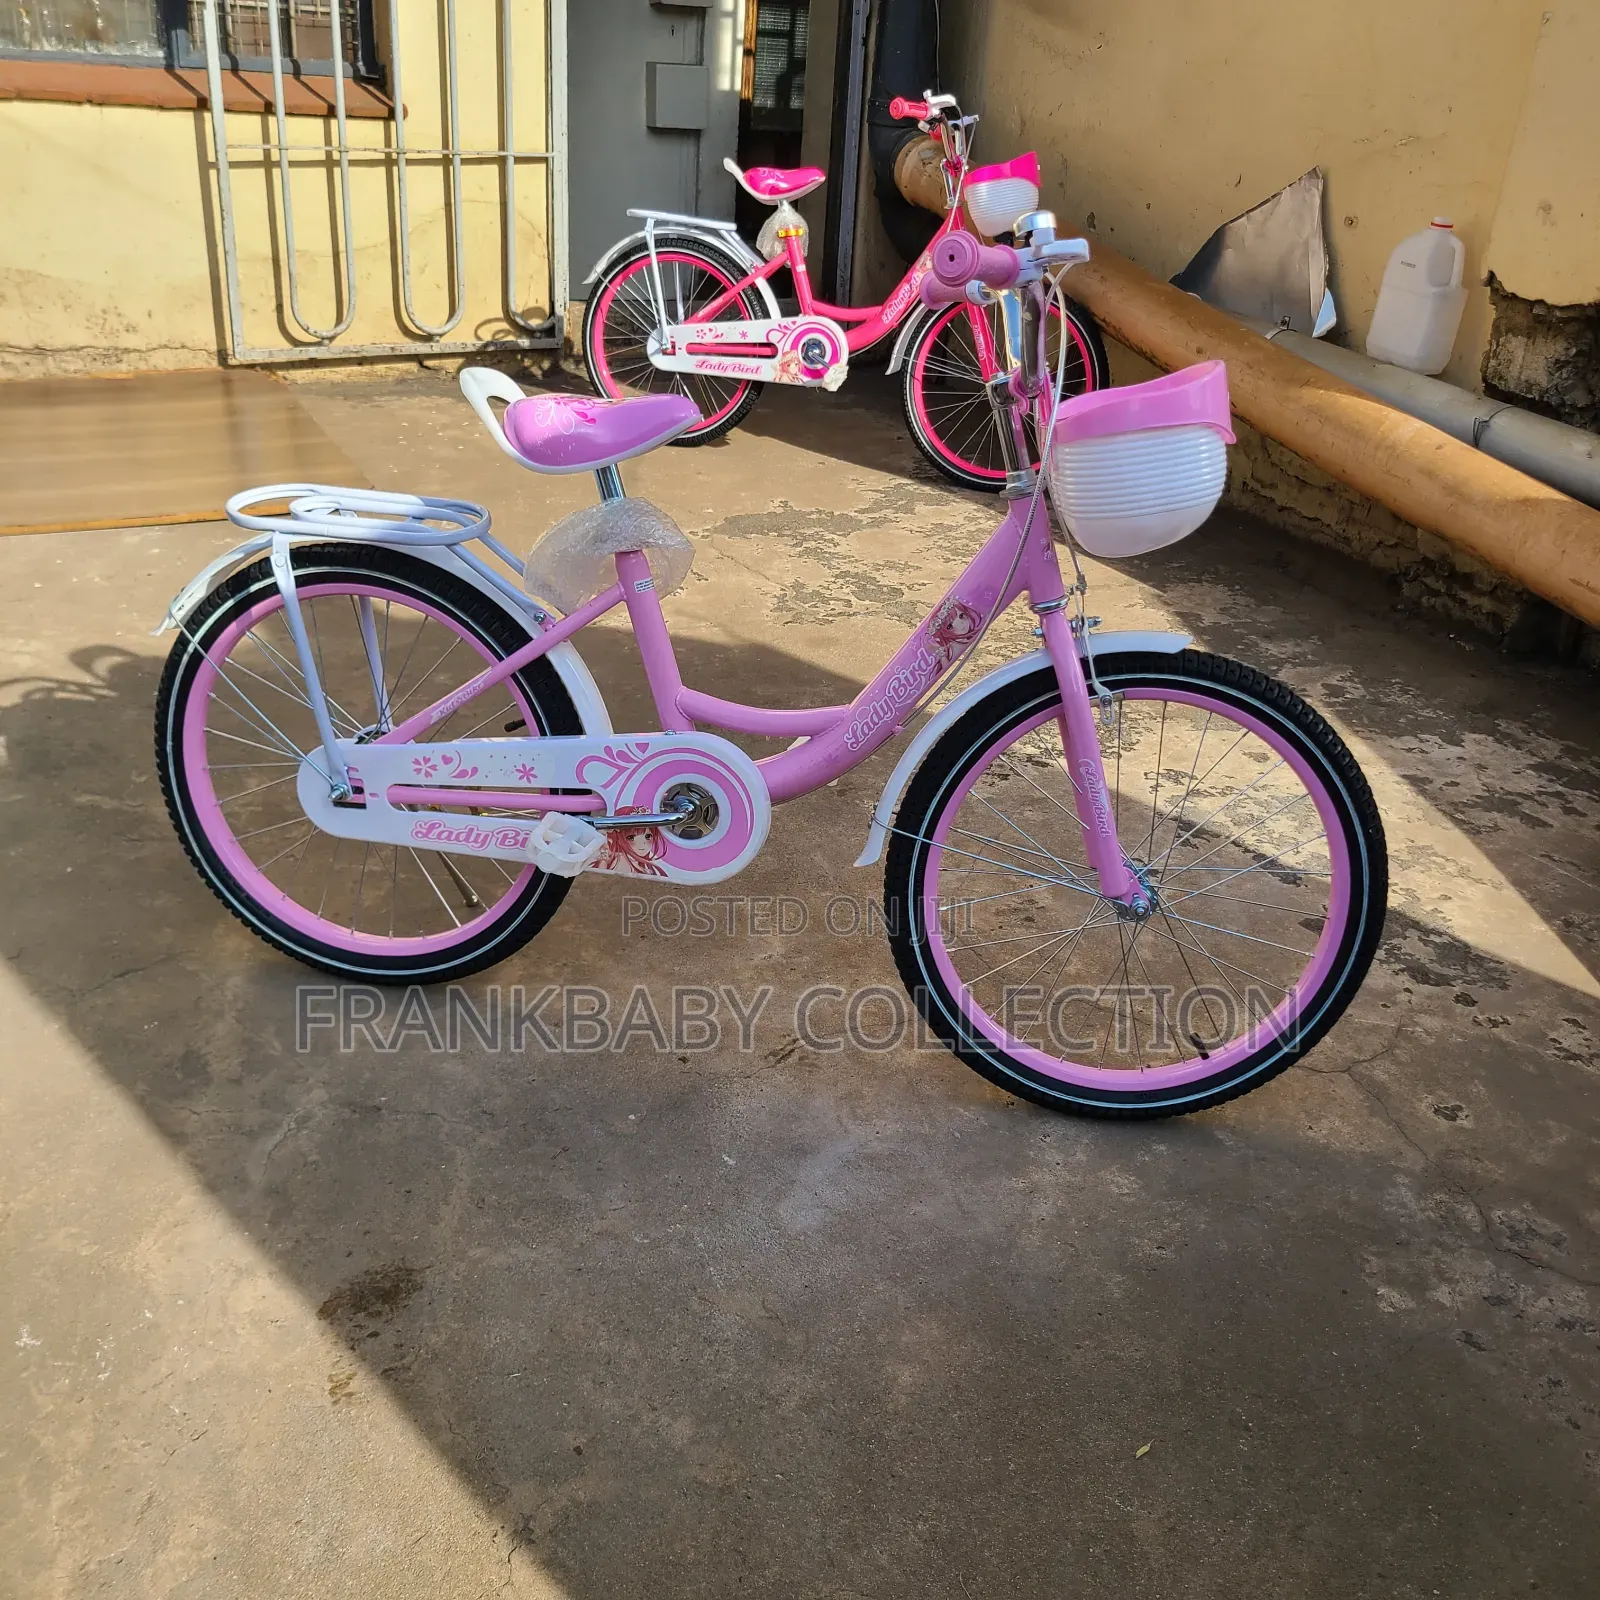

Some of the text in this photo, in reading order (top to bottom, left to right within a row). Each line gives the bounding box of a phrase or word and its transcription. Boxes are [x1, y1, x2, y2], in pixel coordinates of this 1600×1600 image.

[695, 360, 762, 375] Lady Bird
[844, 648, 936, 750] Lady Bird
[1085, 766, 1111, 837] Lady Bird
[411, 819, 534, 851] Lady Bi
